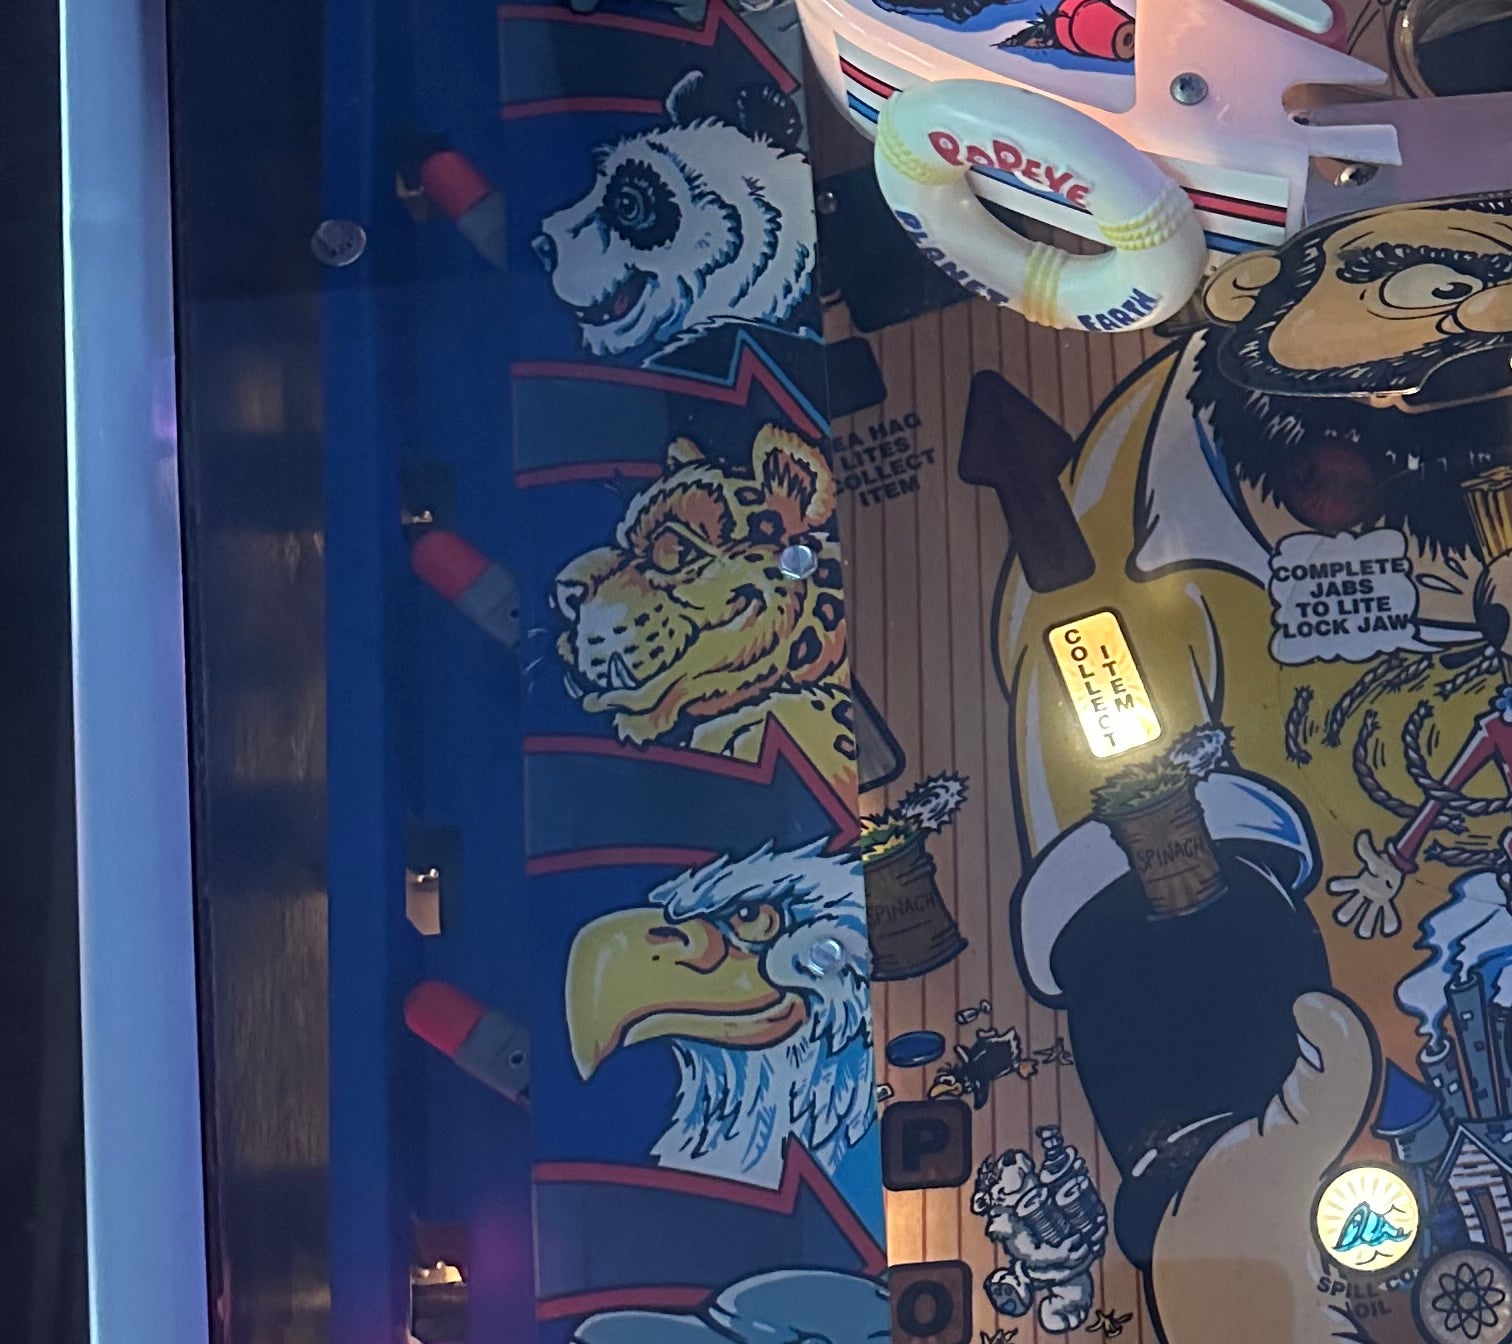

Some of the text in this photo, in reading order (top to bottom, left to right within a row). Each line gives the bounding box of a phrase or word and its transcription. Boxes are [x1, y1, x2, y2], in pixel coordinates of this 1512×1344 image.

[1077, 287, 1162, 333] EARTH
[832, 411, 923, 453] EA HAG
[848, 437, 912, 474] LITES
[857, 476, 922, 509] ITEM
[1272, 557, 1407, 584] COMPLETE
[1310, 577, 1375, 599] JABS
[1296, 595, 1393, 619] TO LITE
[1282, 612, 1411, 640] LOCK JAW
[1063, 627, 1118, 749] COLLECT
[1099, 643, 1136, 713] ITEM
[1135, 834, 1203, 873] SPINACH
[903, 1117, 950, 1171] P
[1316, 1275, 1380, 1299] SPILL
[897, 1279, 954, 1338] O
[1354, 1299, 1392, 1319] OIL
